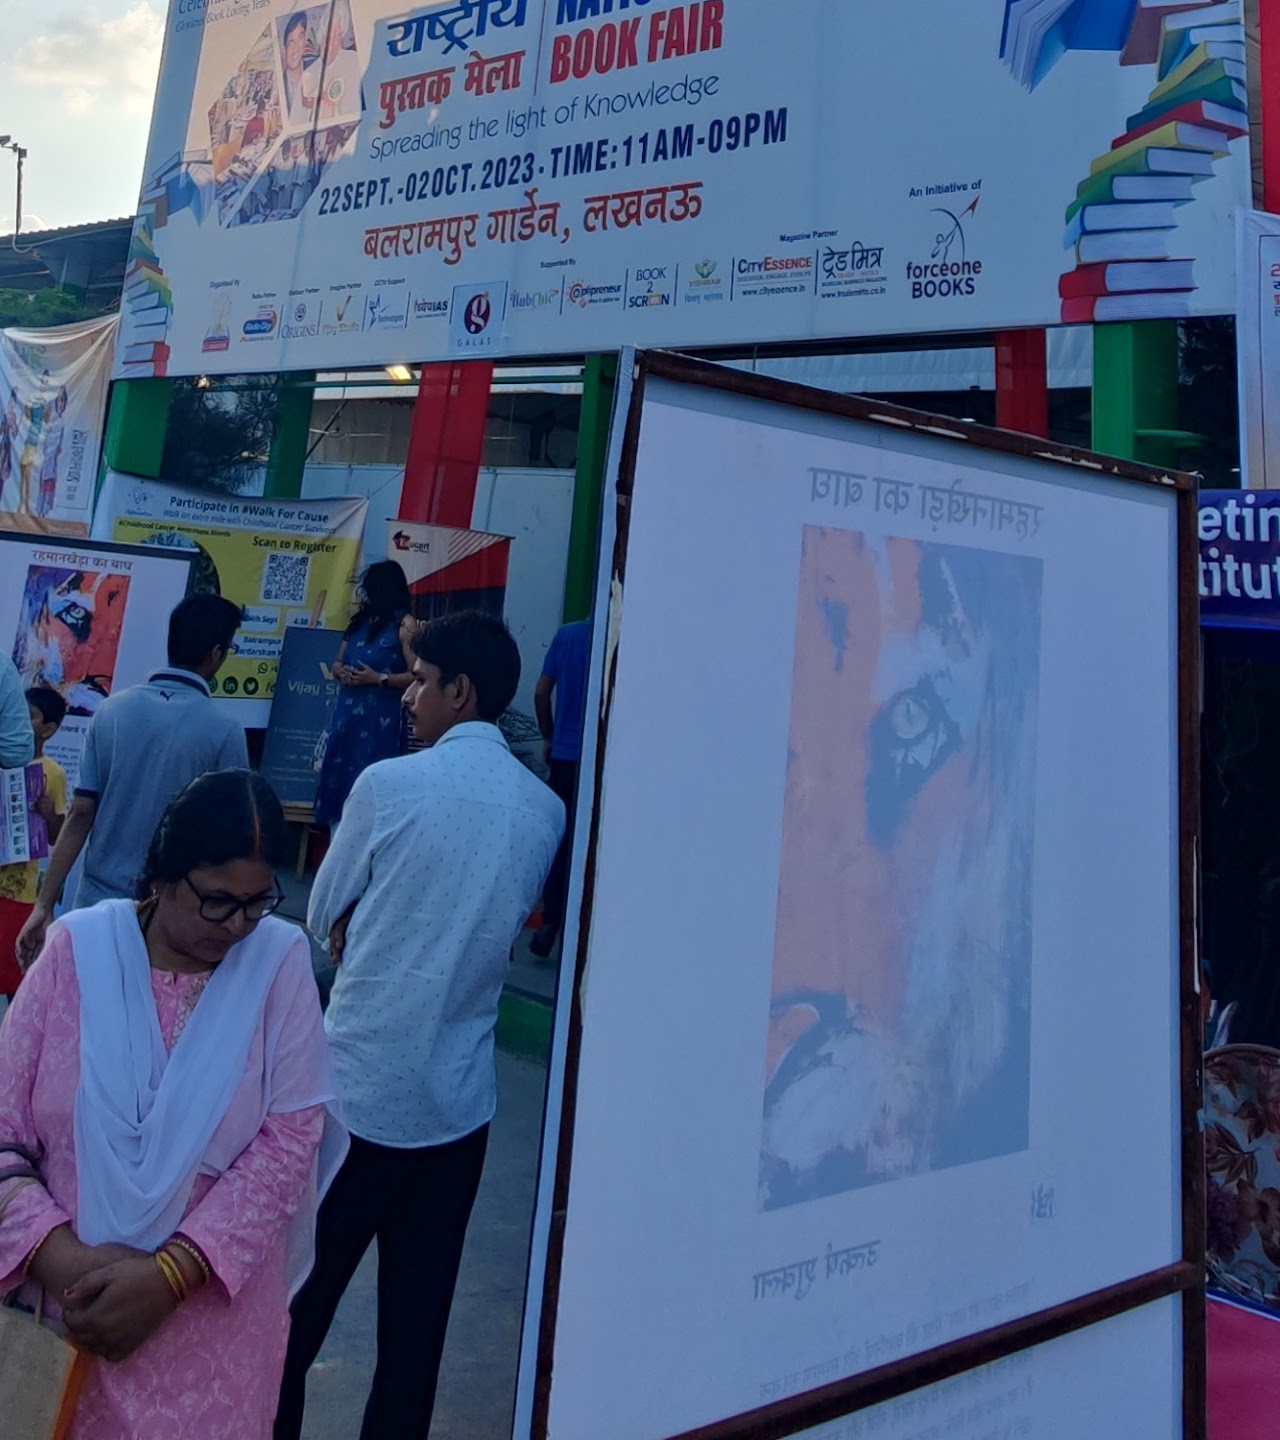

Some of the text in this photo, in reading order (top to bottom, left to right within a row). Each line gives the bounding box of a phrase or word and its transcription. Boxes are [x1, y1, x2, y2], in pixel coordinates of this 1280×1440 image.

[549, 16, 642, 85] BOOK
[379, 50, 526, 129] पुस्तक मेला
[370, 74, 719, 160] Spreading the light of Knowledge
[909, 179, 982, 198] An Initiative of
[364, 213, 478, 265] बलरामपुर
[584, 181, 704, 232] लखनऊ
[779, 230, 839, 243] Magazine Partner
[636, 267, 667, 281] BOOK
[906, 260, 982, 280] forceone
[647, 281, 653, 293] 2
[911, 277, 976, 299] BOOKS
[457, 337, 492, 348] GALAS
[170, 496, 329, 523] Participate in #Walk For Cause
[252, 536, 337, 554] Scan to Register
[91, 556, 109, 569] का
[288, 680, 320, 696] Vijay
